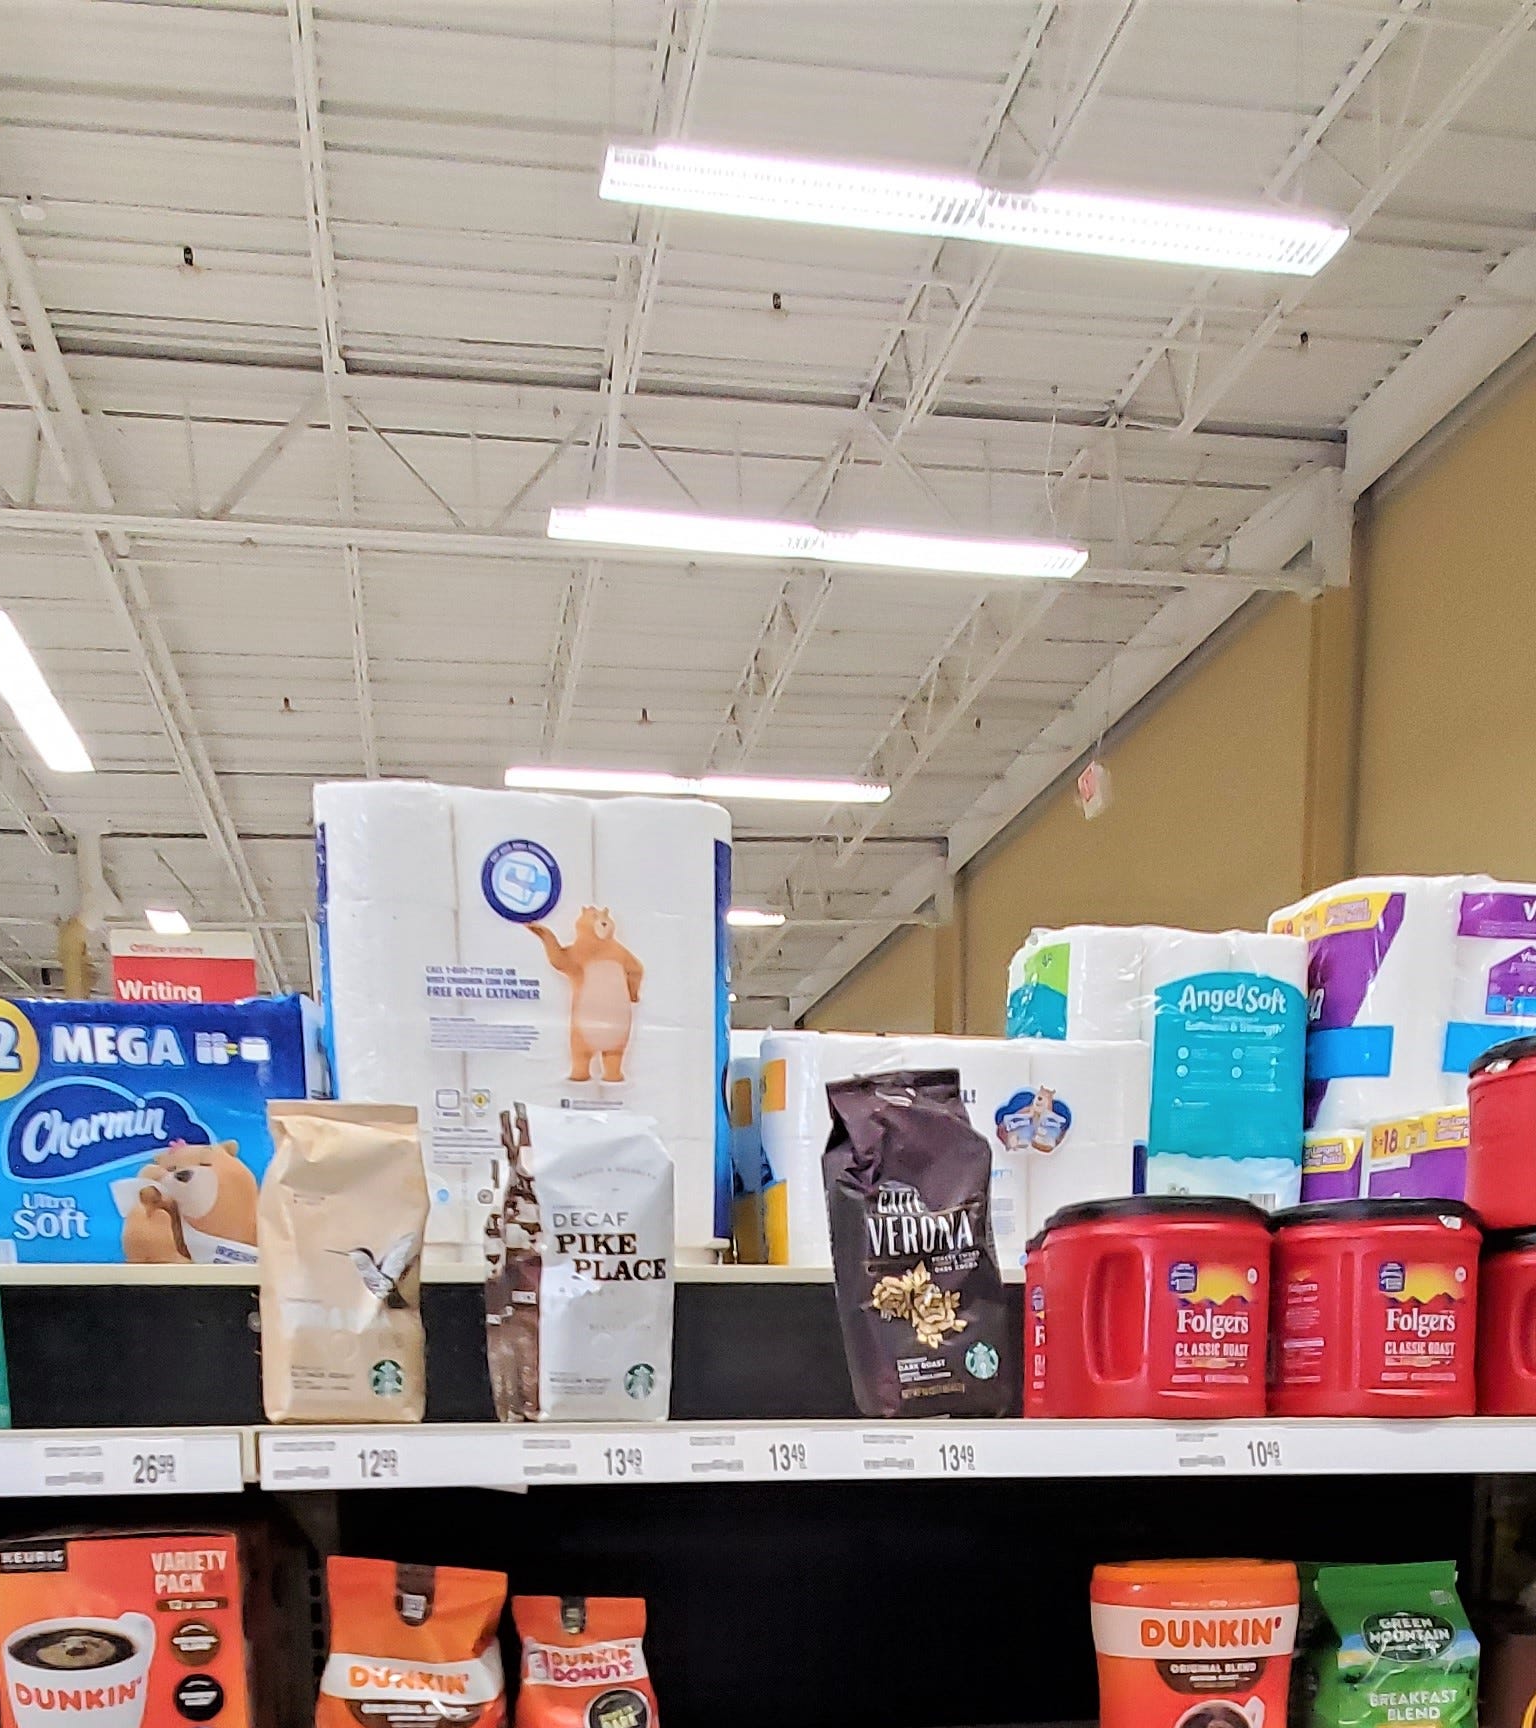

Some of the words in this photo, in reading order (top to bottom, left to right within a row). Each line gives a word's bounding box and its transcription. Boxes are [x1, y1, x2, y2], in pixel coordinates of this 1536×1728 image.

[117, 980, 202, 1003] Writing
[426, 986, 453, 998] FREE
[456, 987, 483, 999] ROLL
[485, 989, 541, 1000] EXTENDER
[52, 1025, 185, 1066] MEGA
[22, 1103, 168, 1164] Charmin
[13, 1207, 90, 1240] Soft
[552, 1211, 629, 1228] DECAF
[556, 1233, 637, 1255] PIKE
[867, 1210, 975, 1257] VERONA
[574, 1257, 667, 1281] PLACE
[1176, 1307, 1250, 1339] Folgers
[1385, 1307, 1456, 1338] Folgers
[1175, 1341, 1220, 1358] CLASSIC
[1384, 1340, 1428, 1356] CLASSIC
[151, 1551, 227, 1572] VARIETY
[155, 1573, 205, 1594] PACK
[1140, 1616, 1283, 1649] DUNKIN'
[1170, 1662, 1222, 1675] ORIGINAL
[1369, 1689, 1459, 1708] BREAKFAST
[1387, 1703, 1441, 1722] BLEND
